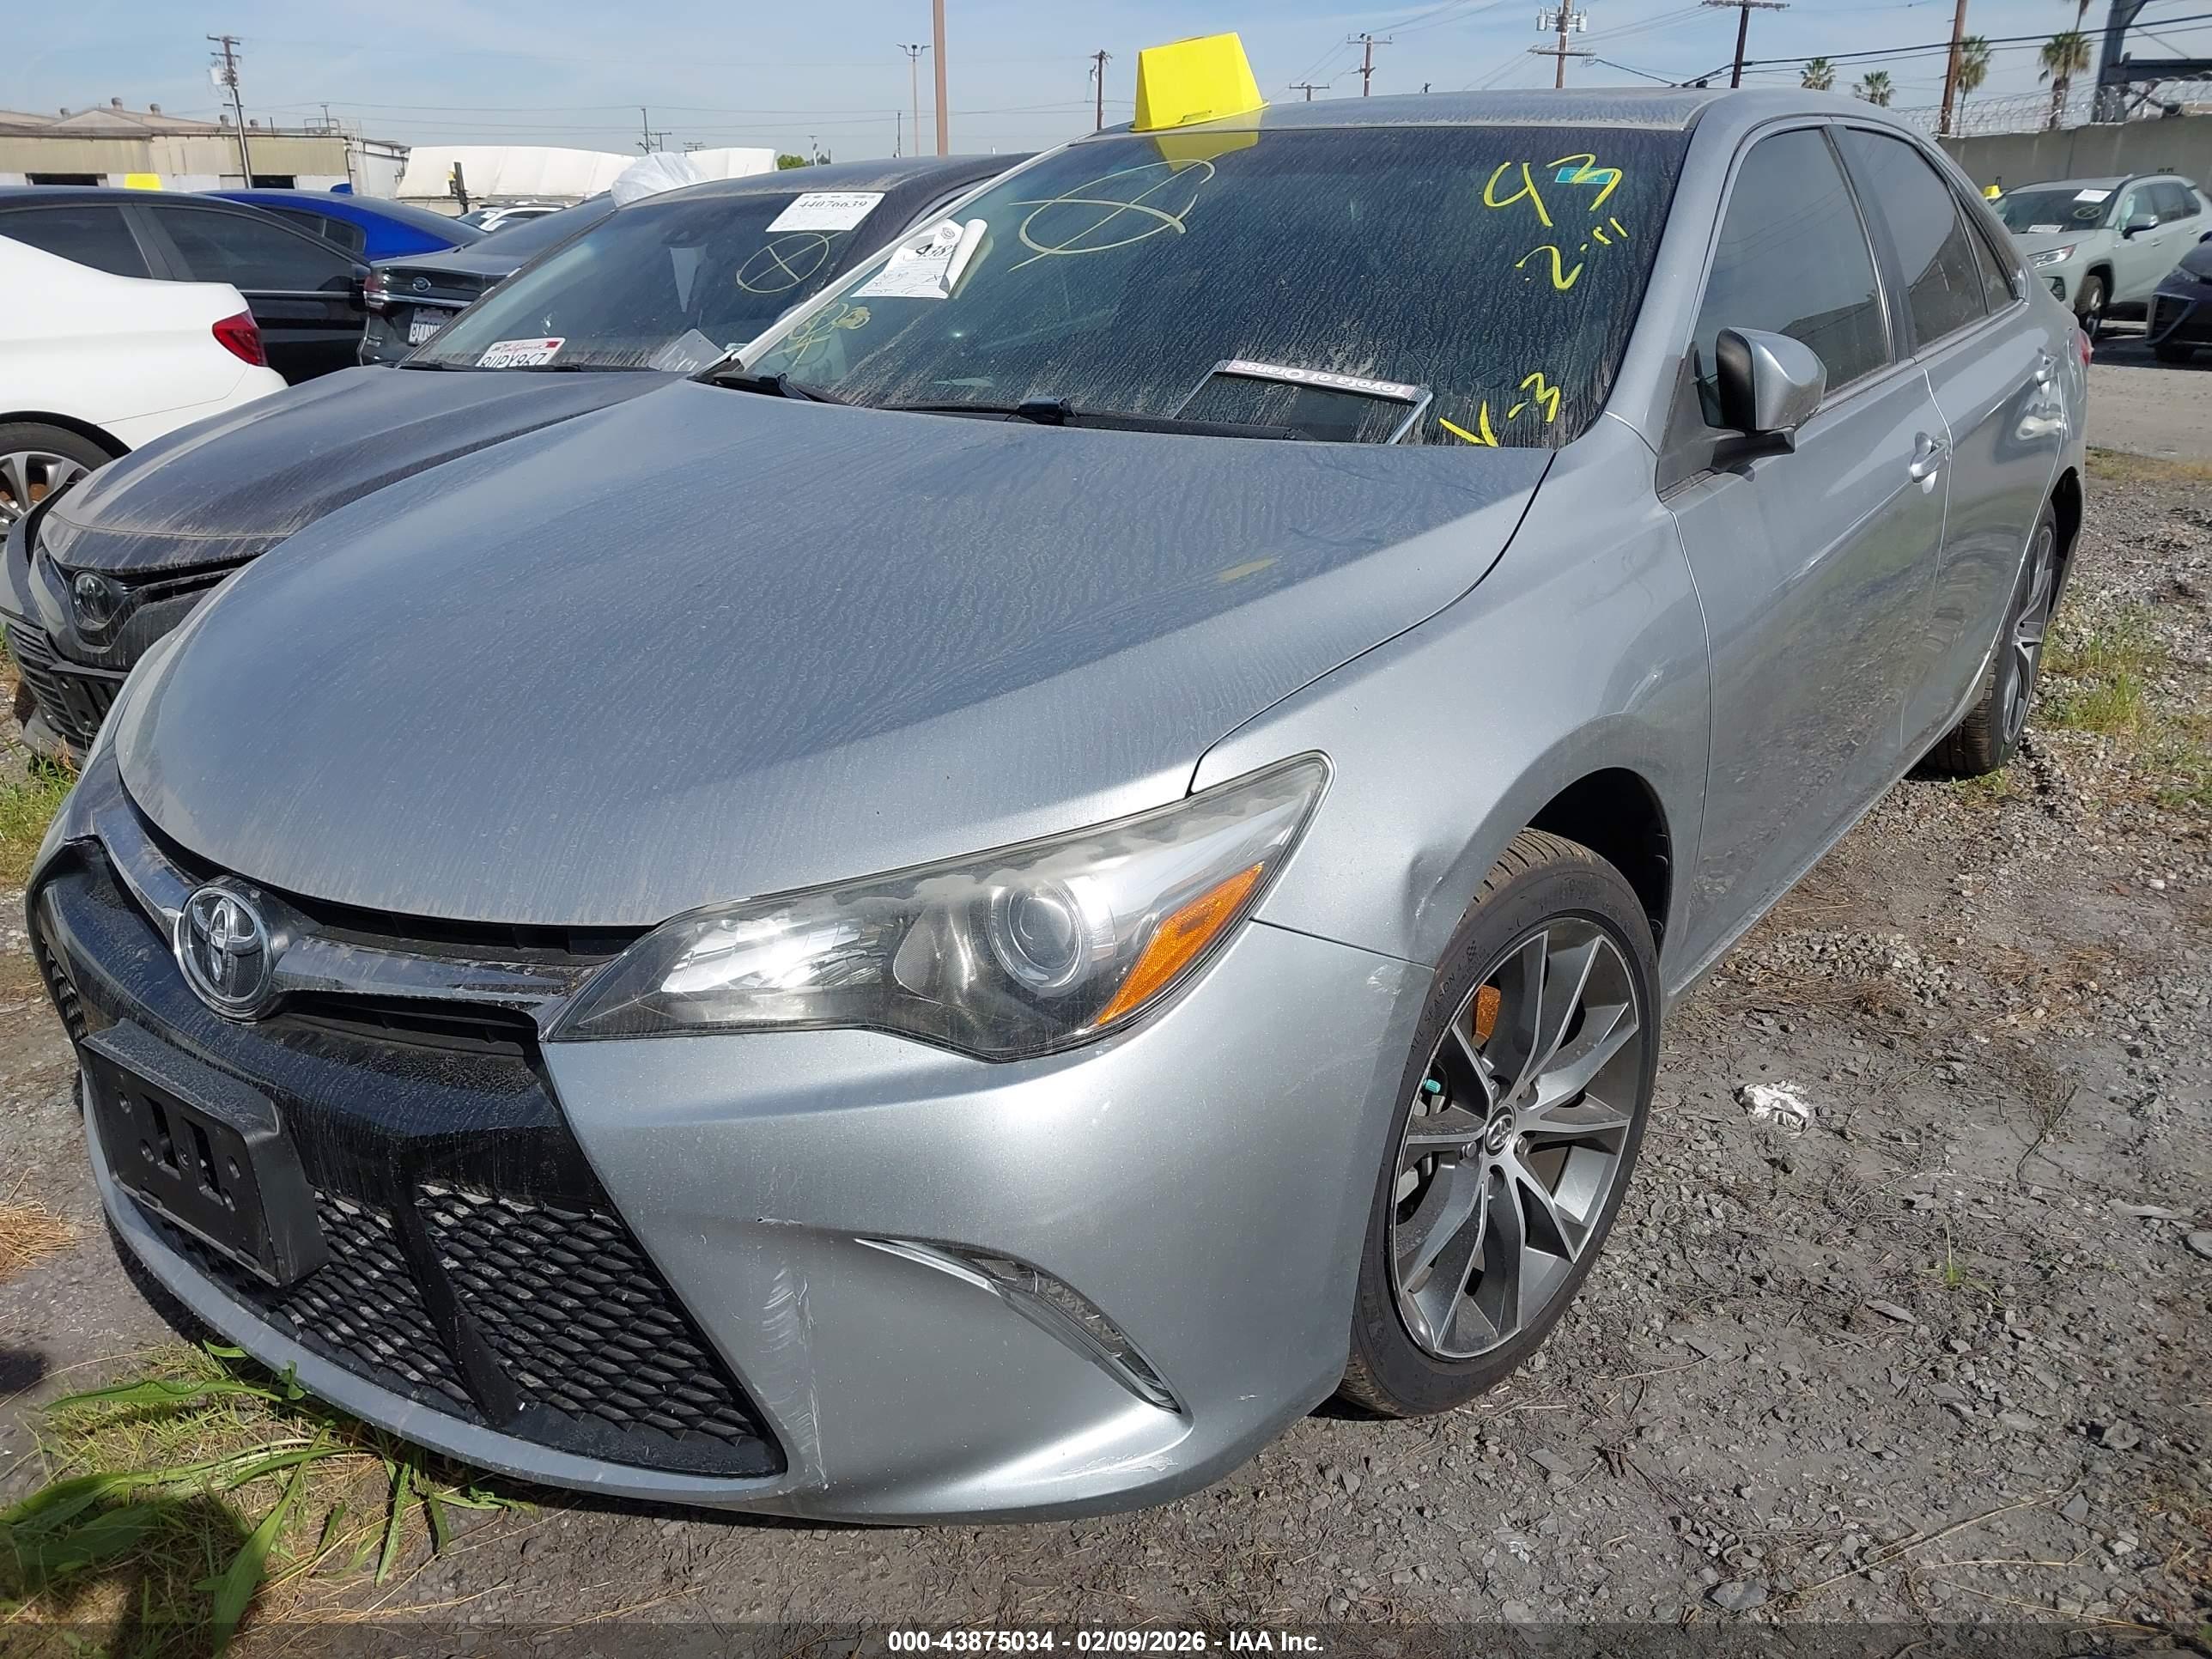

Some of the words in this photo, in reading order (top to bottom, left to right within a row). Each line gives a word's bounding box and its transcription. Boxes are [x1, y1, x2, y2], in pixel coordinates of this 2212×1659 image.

[1231, 362, 1305, 380] Orange
[1306, 372, 1331, 383] of
[1335, 376, 1406, 398] Toyota
